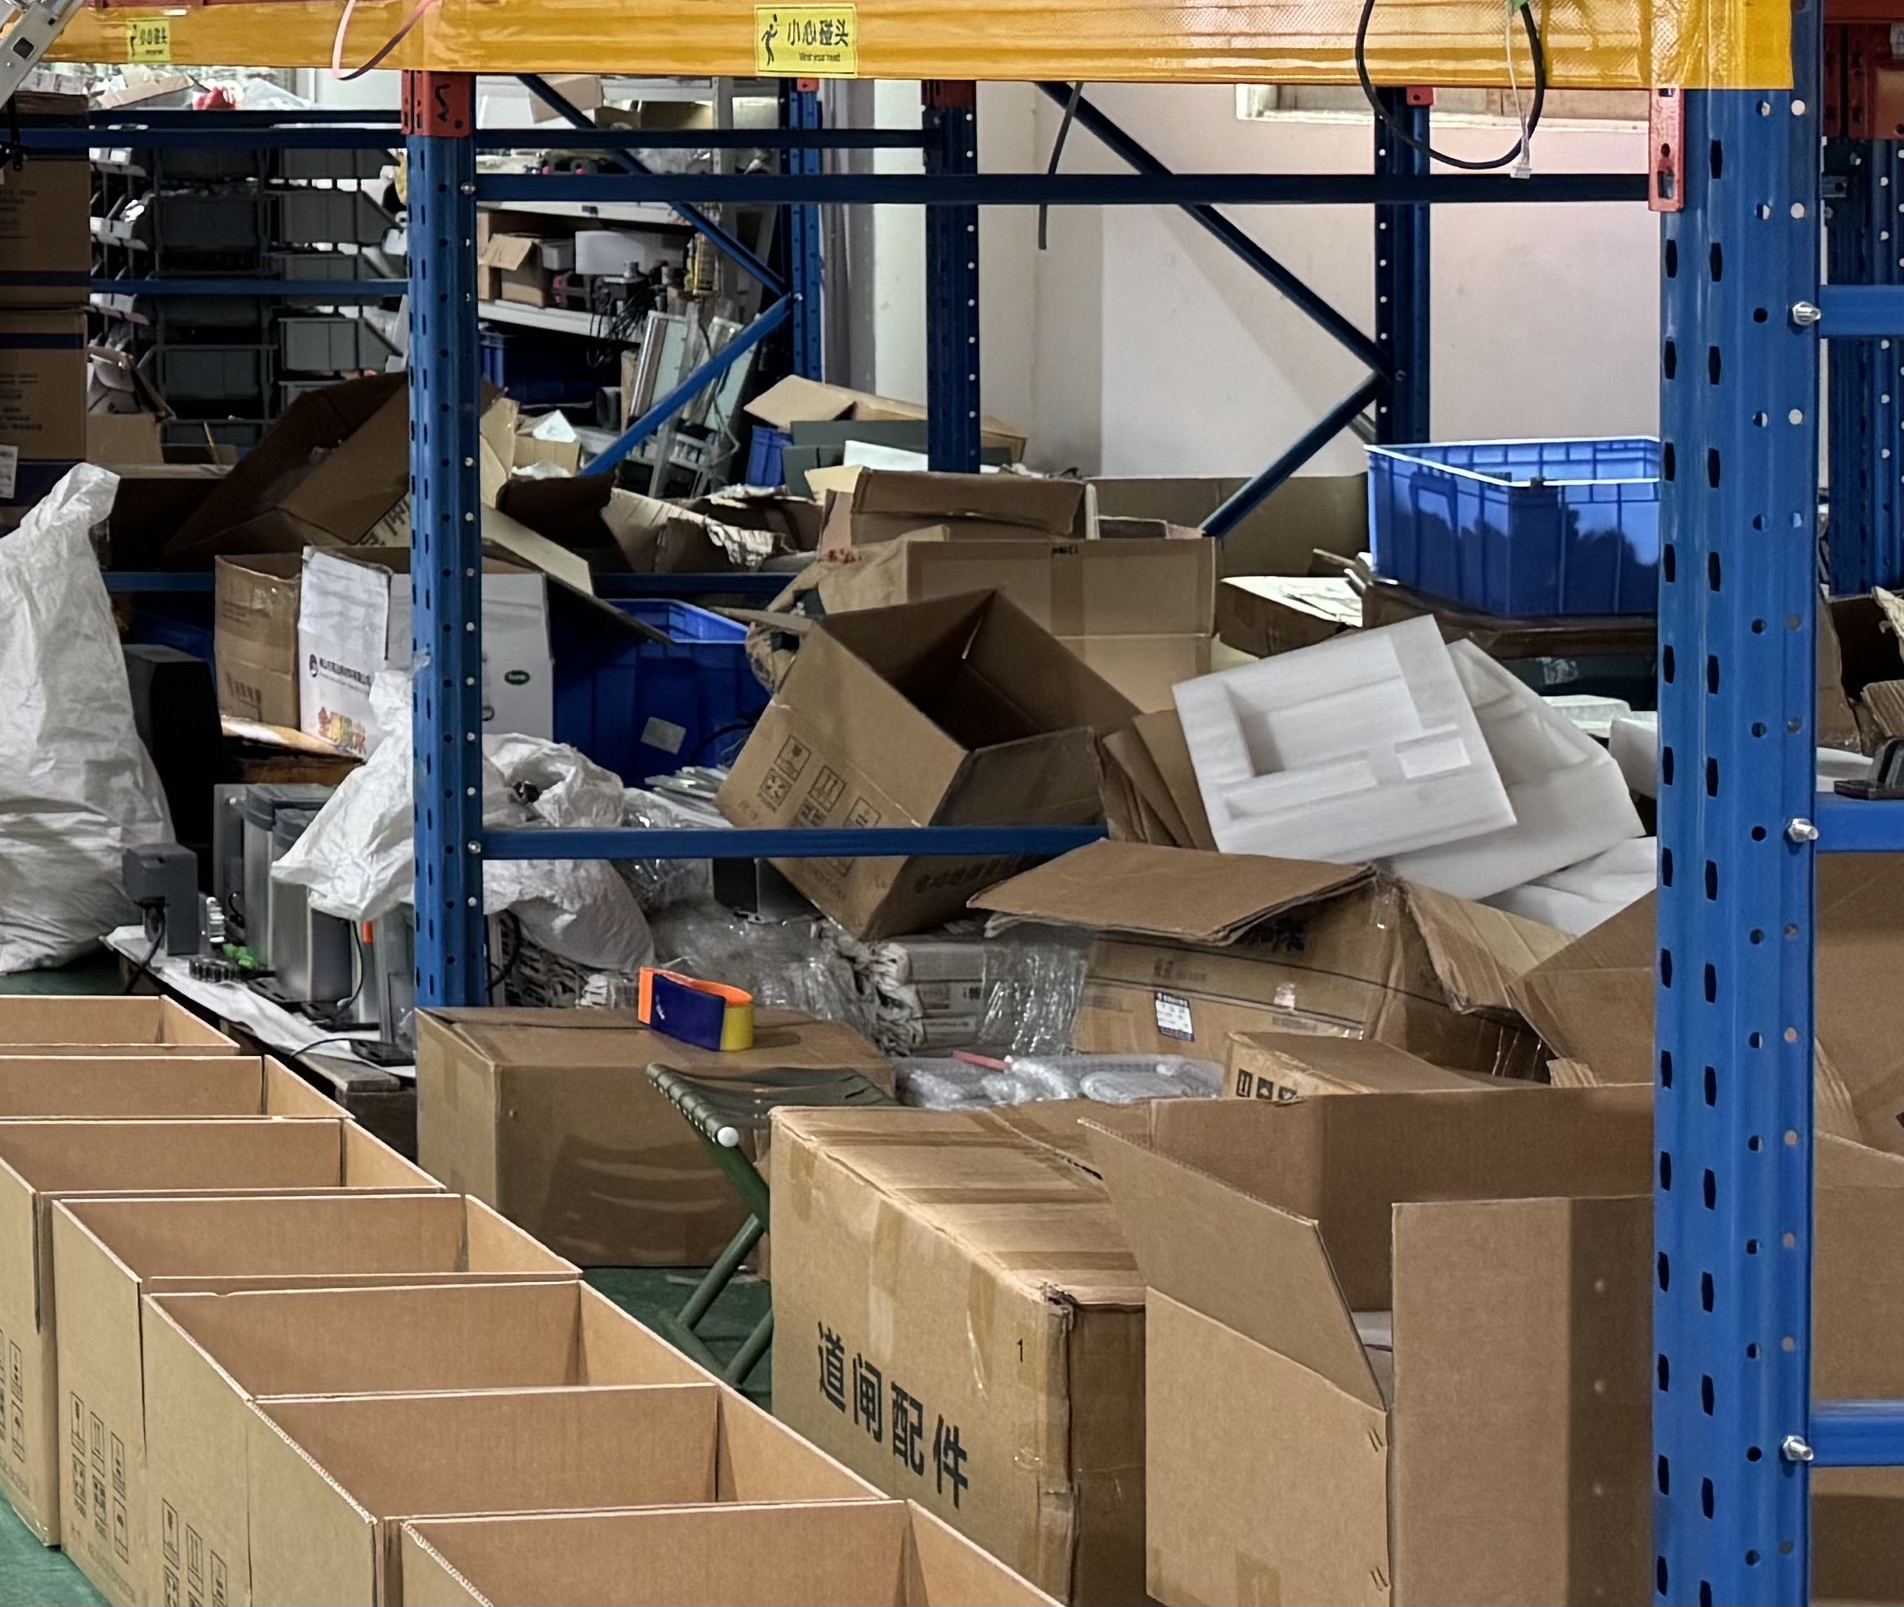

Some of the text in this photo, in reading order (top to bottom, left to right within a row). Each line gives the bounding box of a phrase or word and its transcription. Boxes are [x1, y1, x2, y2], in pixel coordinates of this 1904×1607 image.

[787, 18, 849, 47] 小心碰头
[1016, 1338, 1024, 1364] 1
[817, 1320, 969, 1510] 道闸配件
